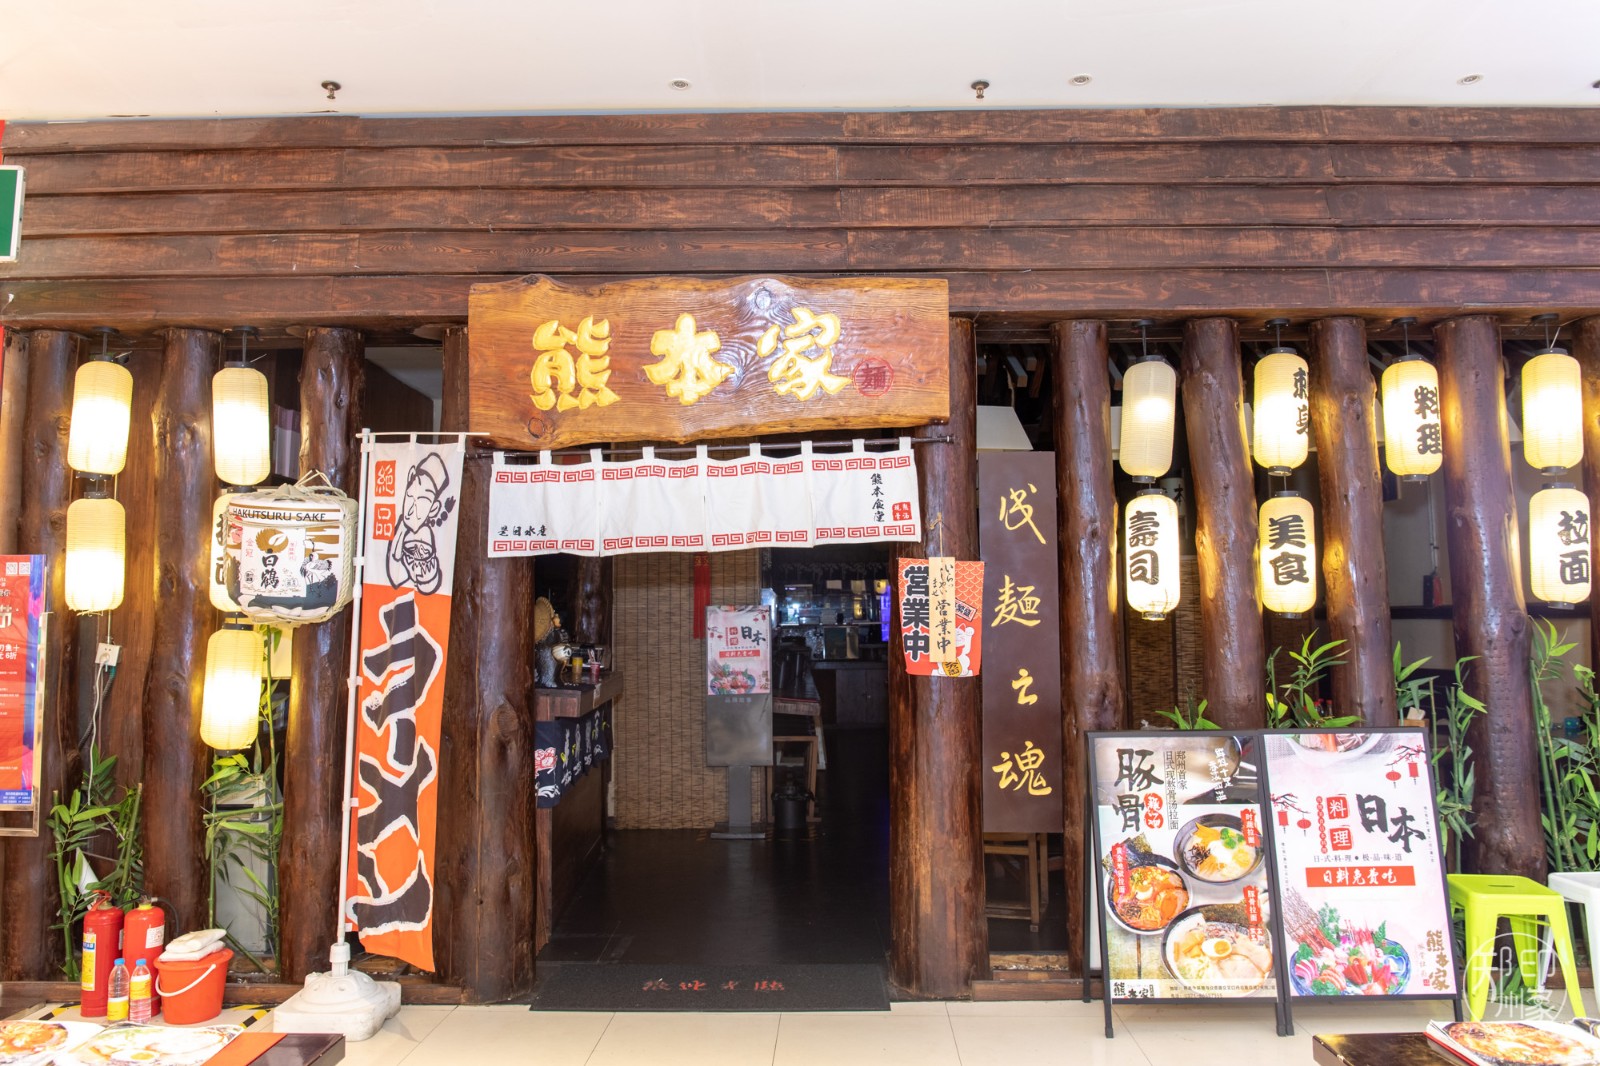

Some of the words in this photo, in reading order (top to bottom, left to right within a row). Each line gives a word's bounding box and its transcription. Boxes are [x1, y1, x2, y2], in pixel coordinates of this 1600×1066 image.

[530, 308, 853, 413] 熊本家
[1414, 385, 1442, 455] 料理
[233, 509, 292, 521] HAKUTSURU
[296, 512, 327, 522] SAKE
[260, 548, 279, 589] 白鶴
[1268, 514, 1310, 586] 美食
[1558, 510, 1590, 585] 拉面
[741, 626, 766, 646] 日本
[347, 591, 443, 938] ラーメン
[1113, 748, 1164, 832] 豚骨
[1176, 750, 1188, 790] 郑州首家
[1328, 798, 1351, 849] 料理
[1356, 794, 1427, 853] 日本
[1426, 930, 1450, 991] 熊本家
